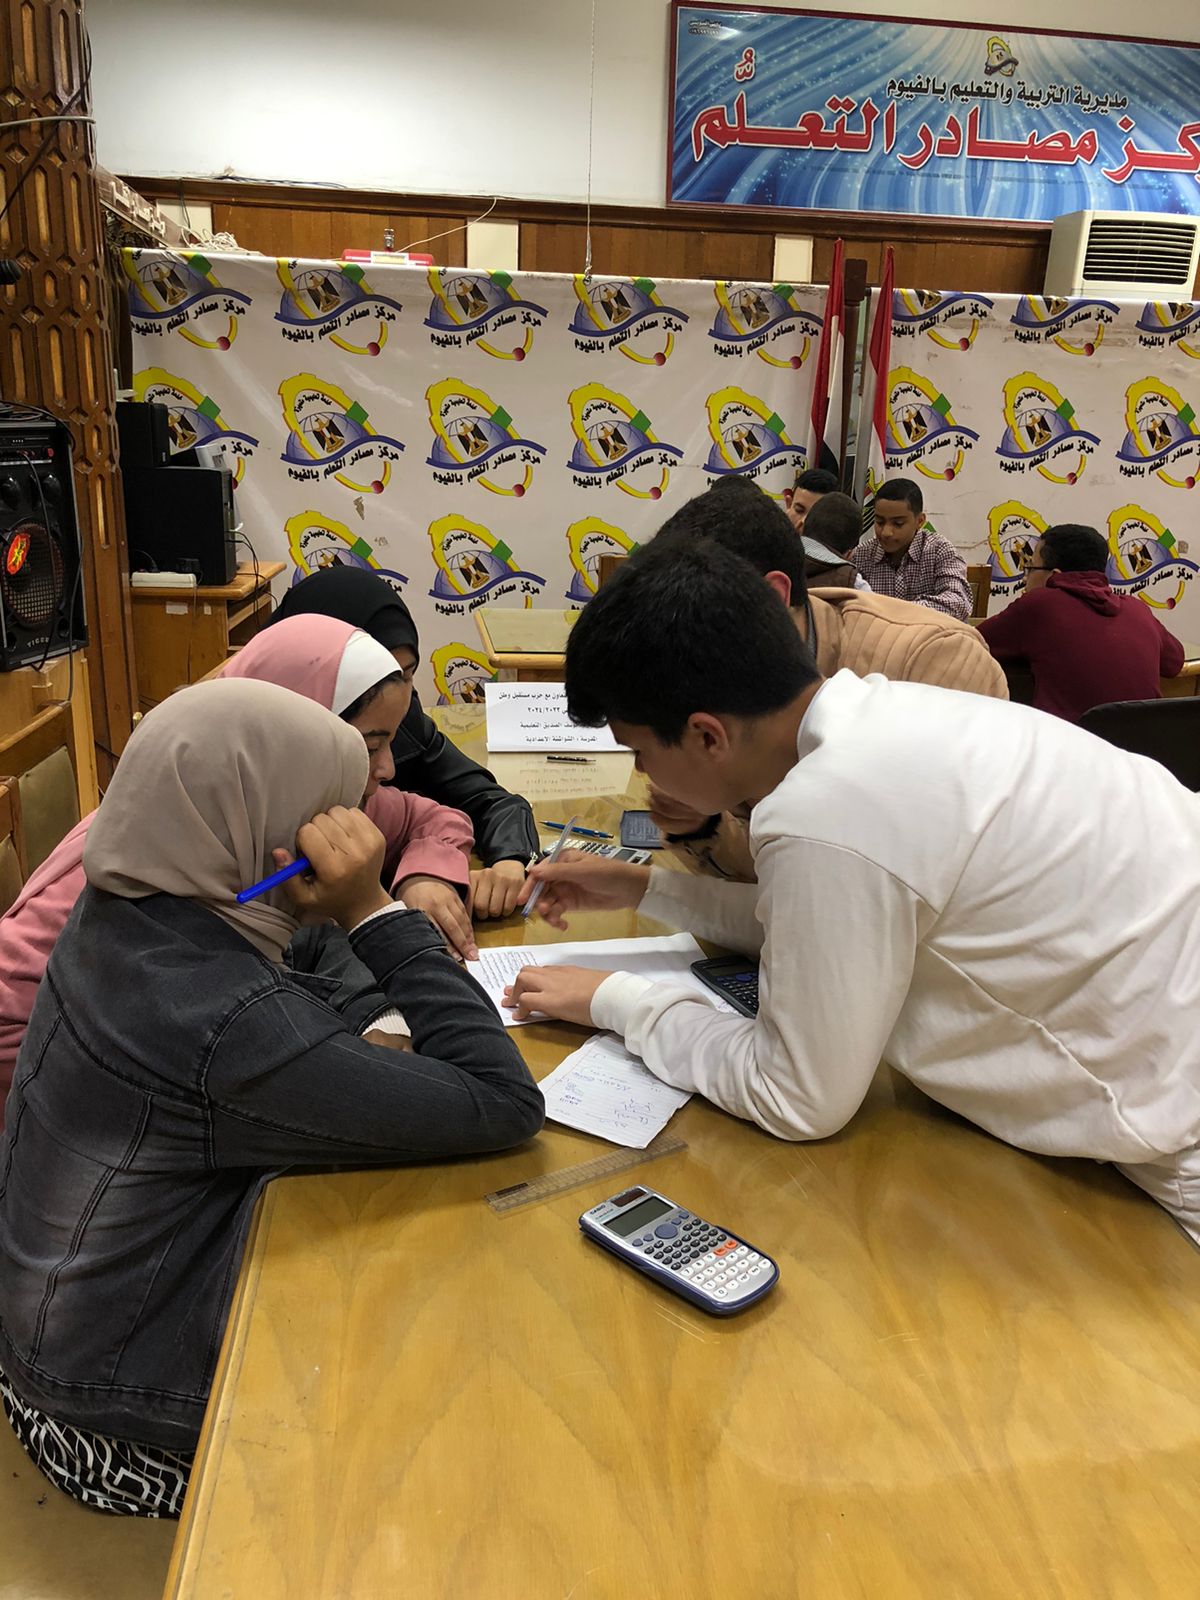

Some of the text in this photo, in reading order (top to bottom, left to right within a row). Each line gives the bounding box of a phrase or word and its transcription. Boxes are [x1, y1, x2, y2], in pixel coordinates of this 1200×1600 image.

[887, 74, 1128, 113] مديرية التربية والتعليم بالفيوم
[899, 105, 1099, 170] مصادر
[1101, 115, 1200, 183] كز
[194, 302, 218, 319] مصادر
[223, 299, 245, 315] مركز
[891, 302, 987, 338] مركز مصادر التعلم بالفيو
[167, 310, 189, 333] التعلم
[282, 305, 396, 343] مركز مصادر التعلم بالفيوم
[431, 311, 541, 349] مركز مصادر التعلم بالفيوم
[575, 316, 682, 353] مركز مصادر التعلم بالفيوم
[1014, 308, 1113, 344] مركز مصادر التعلم بالفيوم
[714, 321, 819, 358] مركز مصادر التعلم بالفيوم
[1139, 335, 1165, 349] بالفيوم
[1169, 326, 1190, 346] التعلم
[231, 441, 253, 456] مركز
[791, 455, 805, 469] ركز
[885, 435, 973, 470] مركز مصادر التعلم بالفي
[1000, 440, 1094, 474] مركز مصادر التعلم بالفيوم
[1171, 447, 1193, 463] مصادر
[288, 445, 399, 482] مركز مصادر التعلم بالفيوم
[433, 449, 541, 486] مركز مصادر التعلم بالفيوم
[573, 452, 678, 489] مركز مصادر التعلم بالفيوم
[764, 457, 787, 474] مصادر
[1119, 464, 1145, 478] بالفيوم
[1149, 455, 1168, 475] التعلم
[1130, 578, 1150, 596] التعلم
[1152, 570, 1173, 585] مصادر
[1176, 567, 1193, 580] مركز
[435, 580, 540, 616] مركز مصادر التعلم بالفيوم
[990, 585, 1009, 596] بالفي
